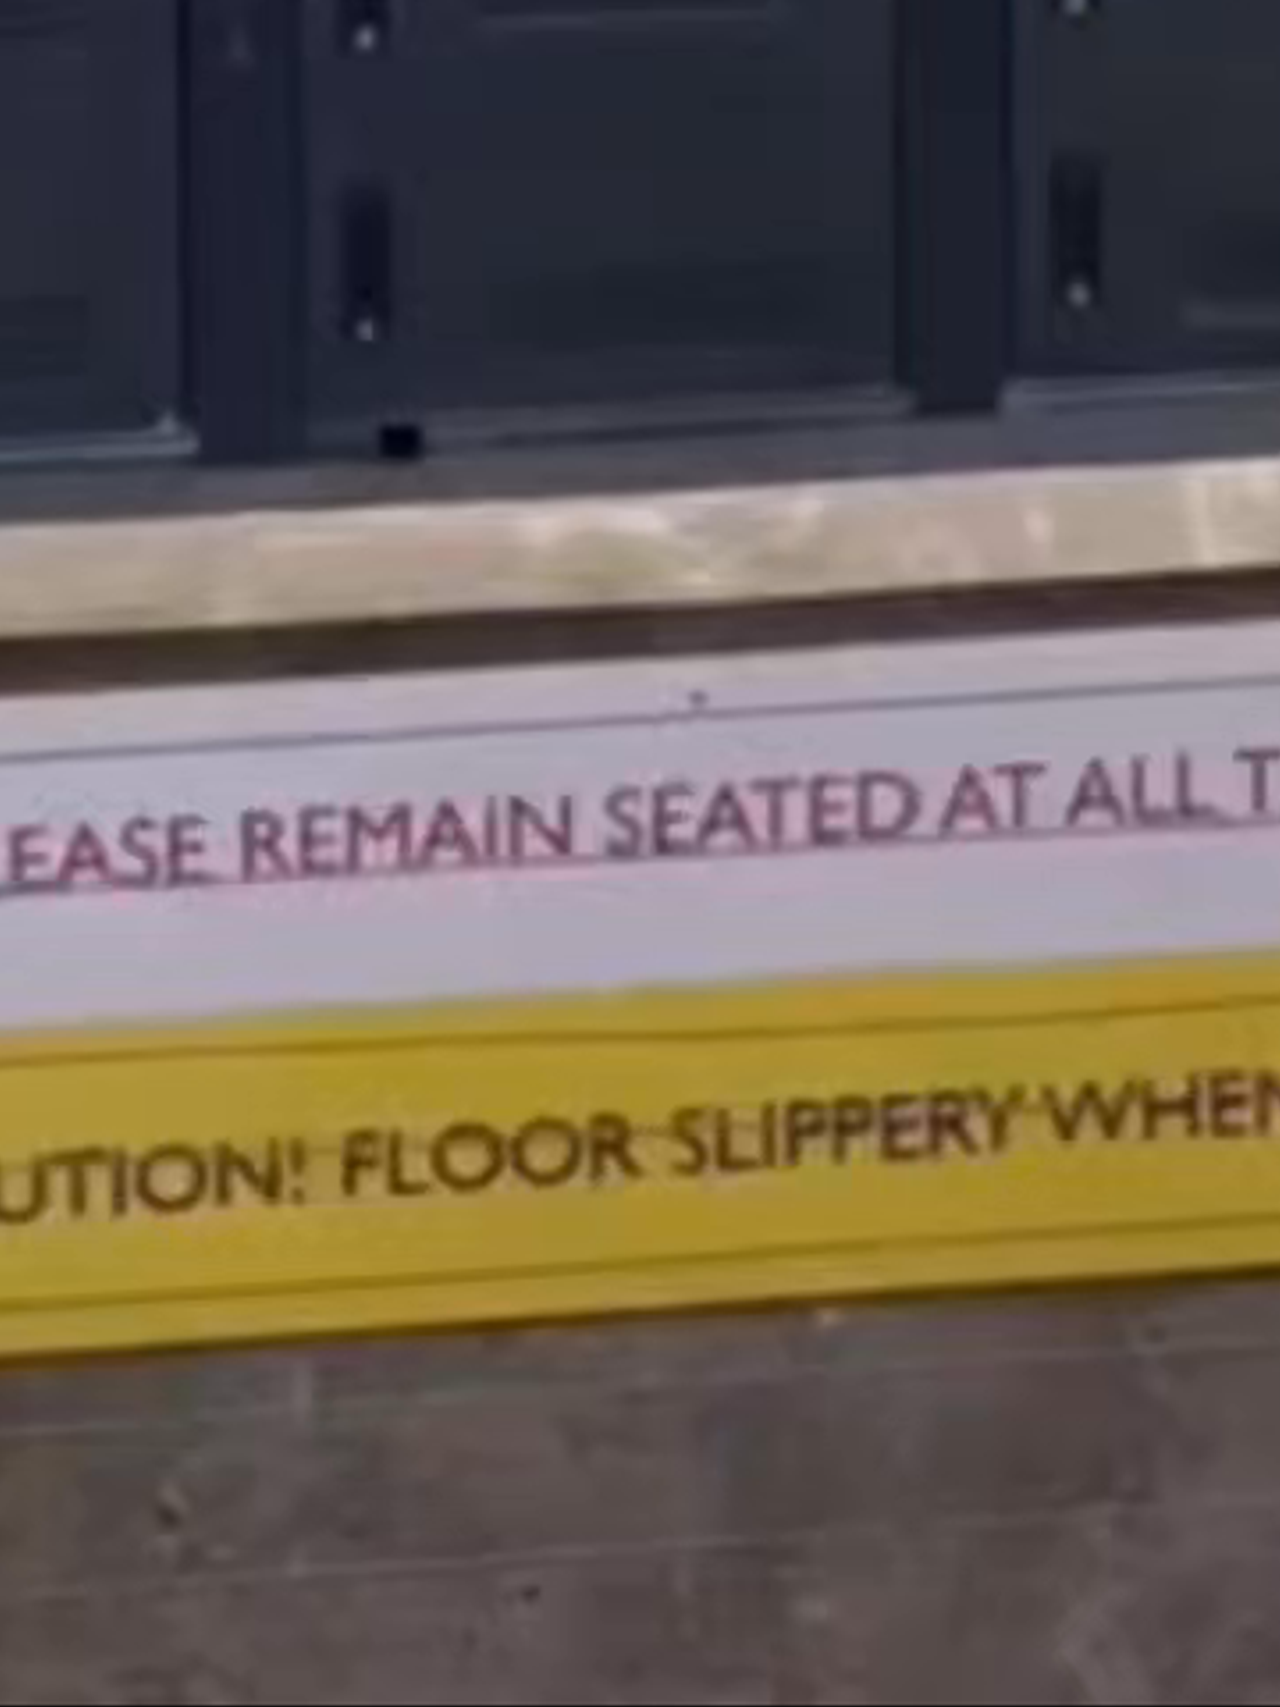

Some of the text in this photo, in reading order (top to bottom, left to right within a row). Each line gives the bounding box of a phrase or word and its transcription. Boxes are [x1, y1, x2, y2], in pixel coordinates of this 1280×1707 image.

[240, 794, 572, 883] REMAIN
[605, 770, 919, 859] SEATED
[937, 761, 1046, 836] AT
[1064, 752, 1217, 827] ALL
[341, 1113, 642, 1197] FLOOR
[671, 1084, 1025, 1178] SLIPPERY
